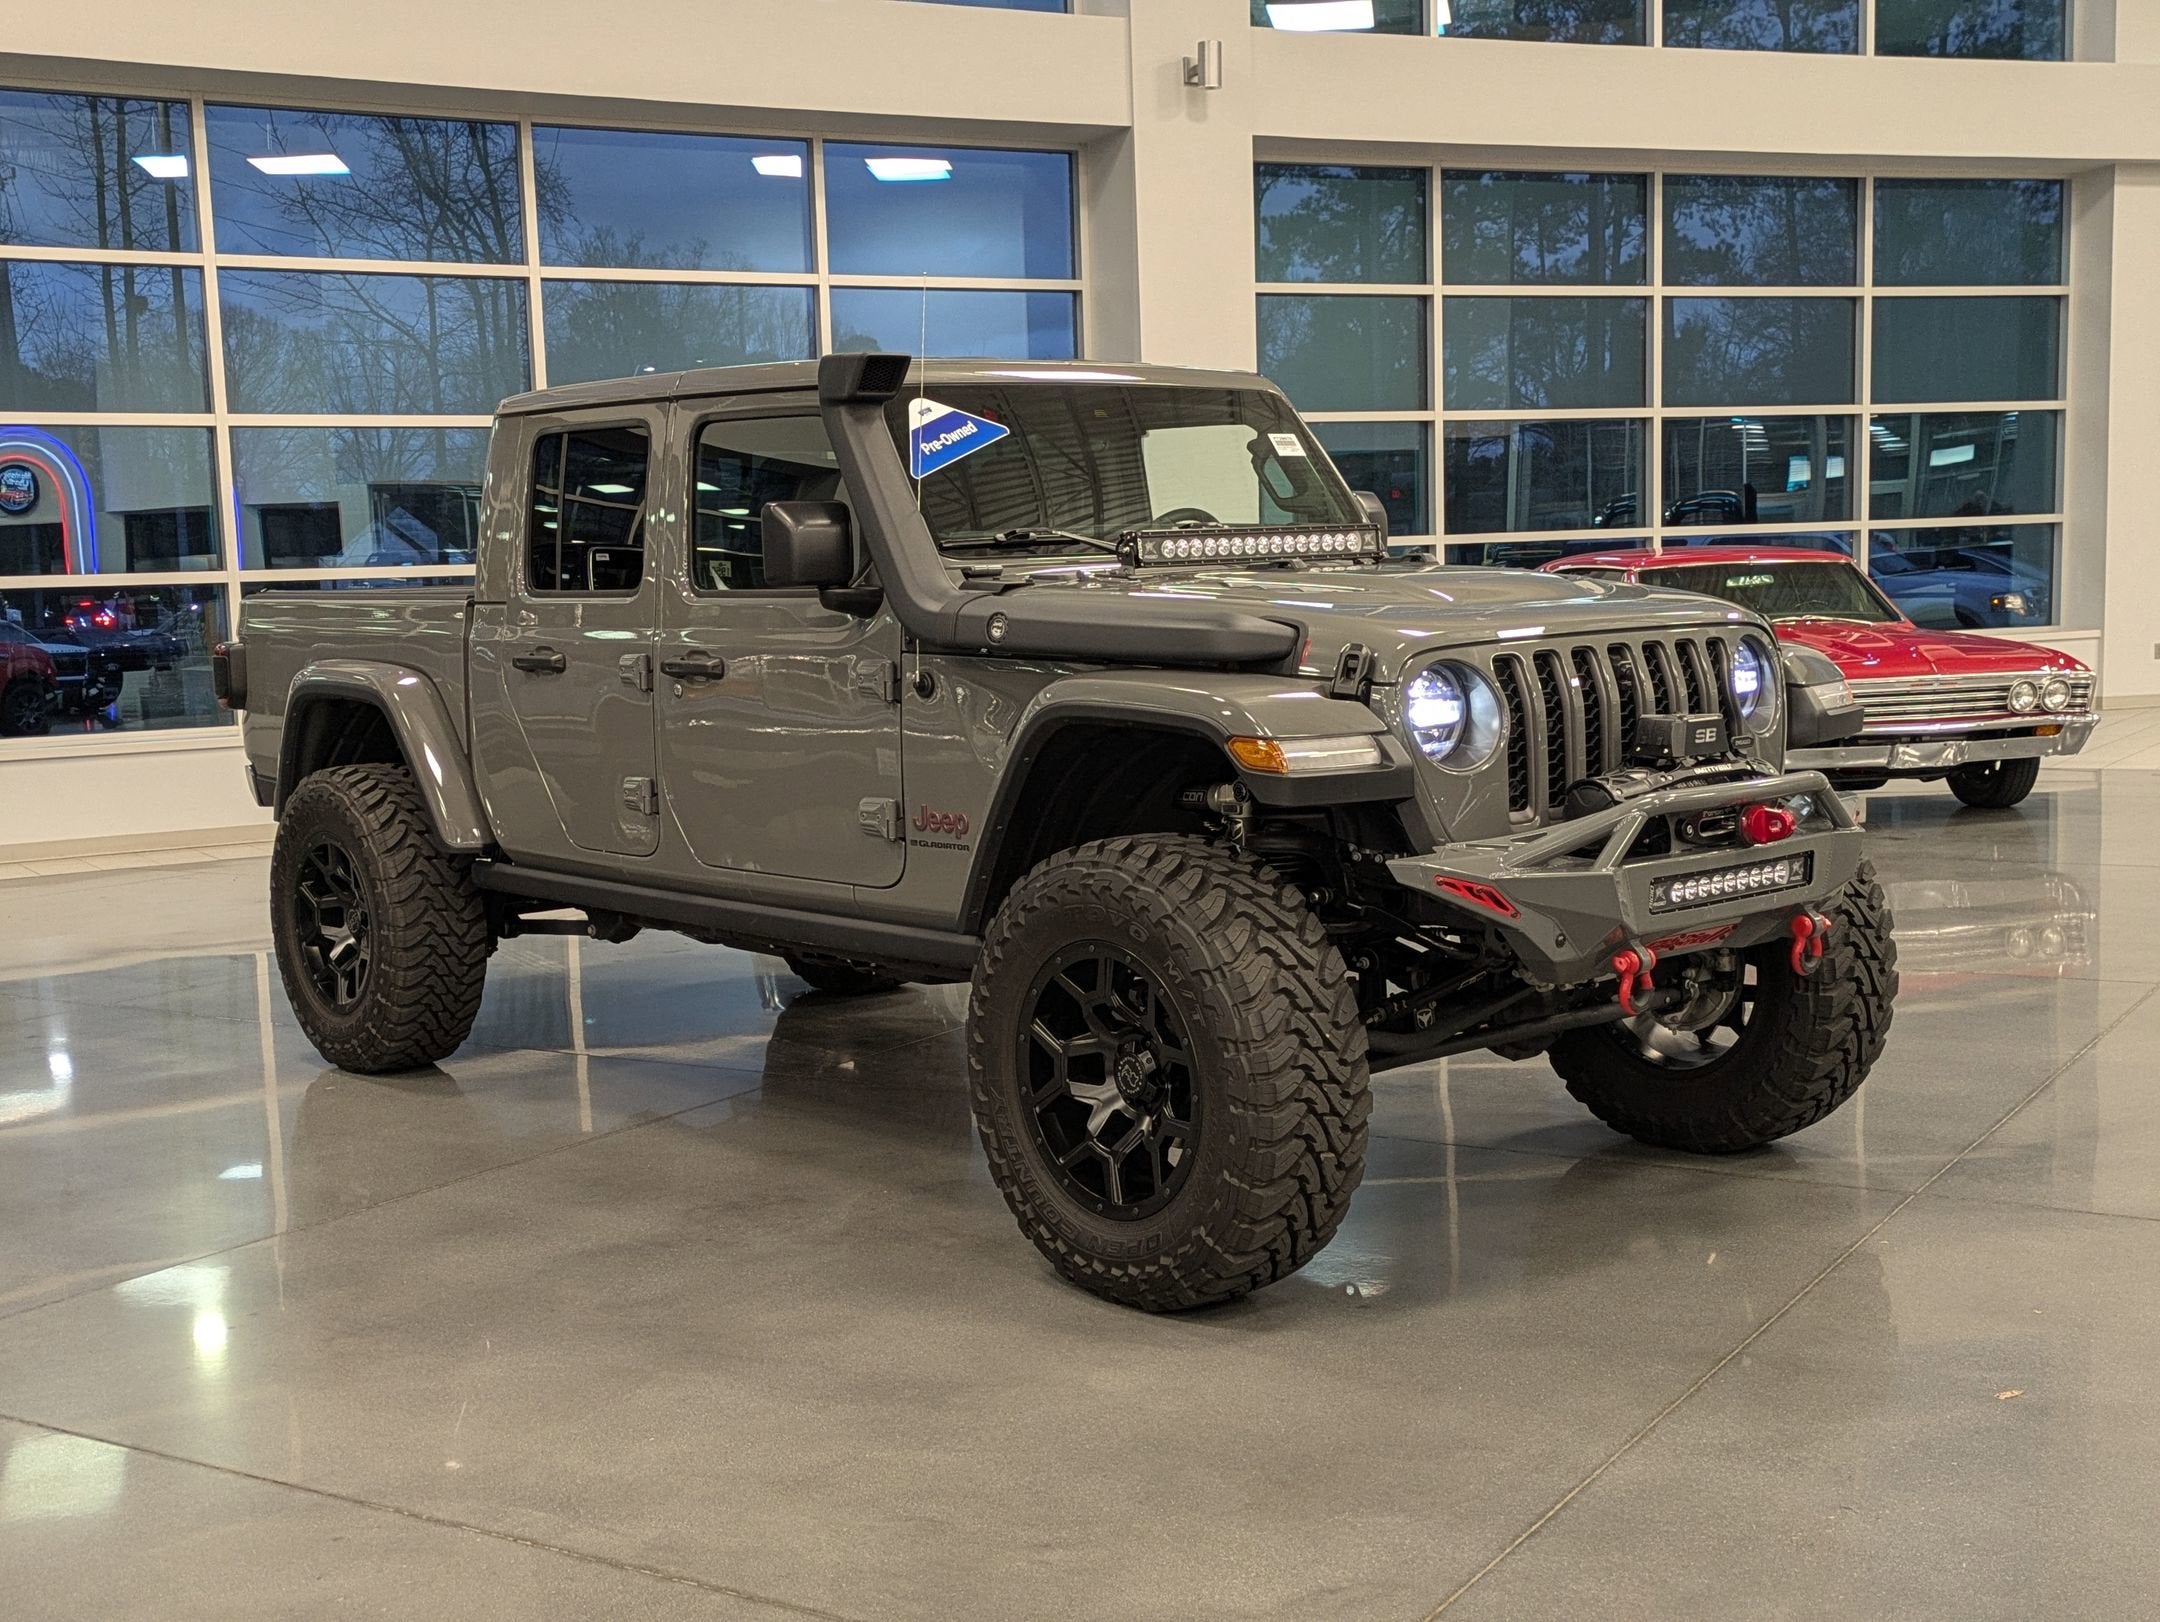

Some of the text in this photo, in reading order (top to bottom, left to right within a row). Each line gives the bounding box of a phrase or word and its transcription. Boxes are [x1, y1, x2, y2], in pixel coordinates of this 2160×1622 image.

[919, 420, 979, 455] Pre-Owned
[912, 803, 969, 840] Jeep
[918, 840, 970, 852] GLADIATOR
